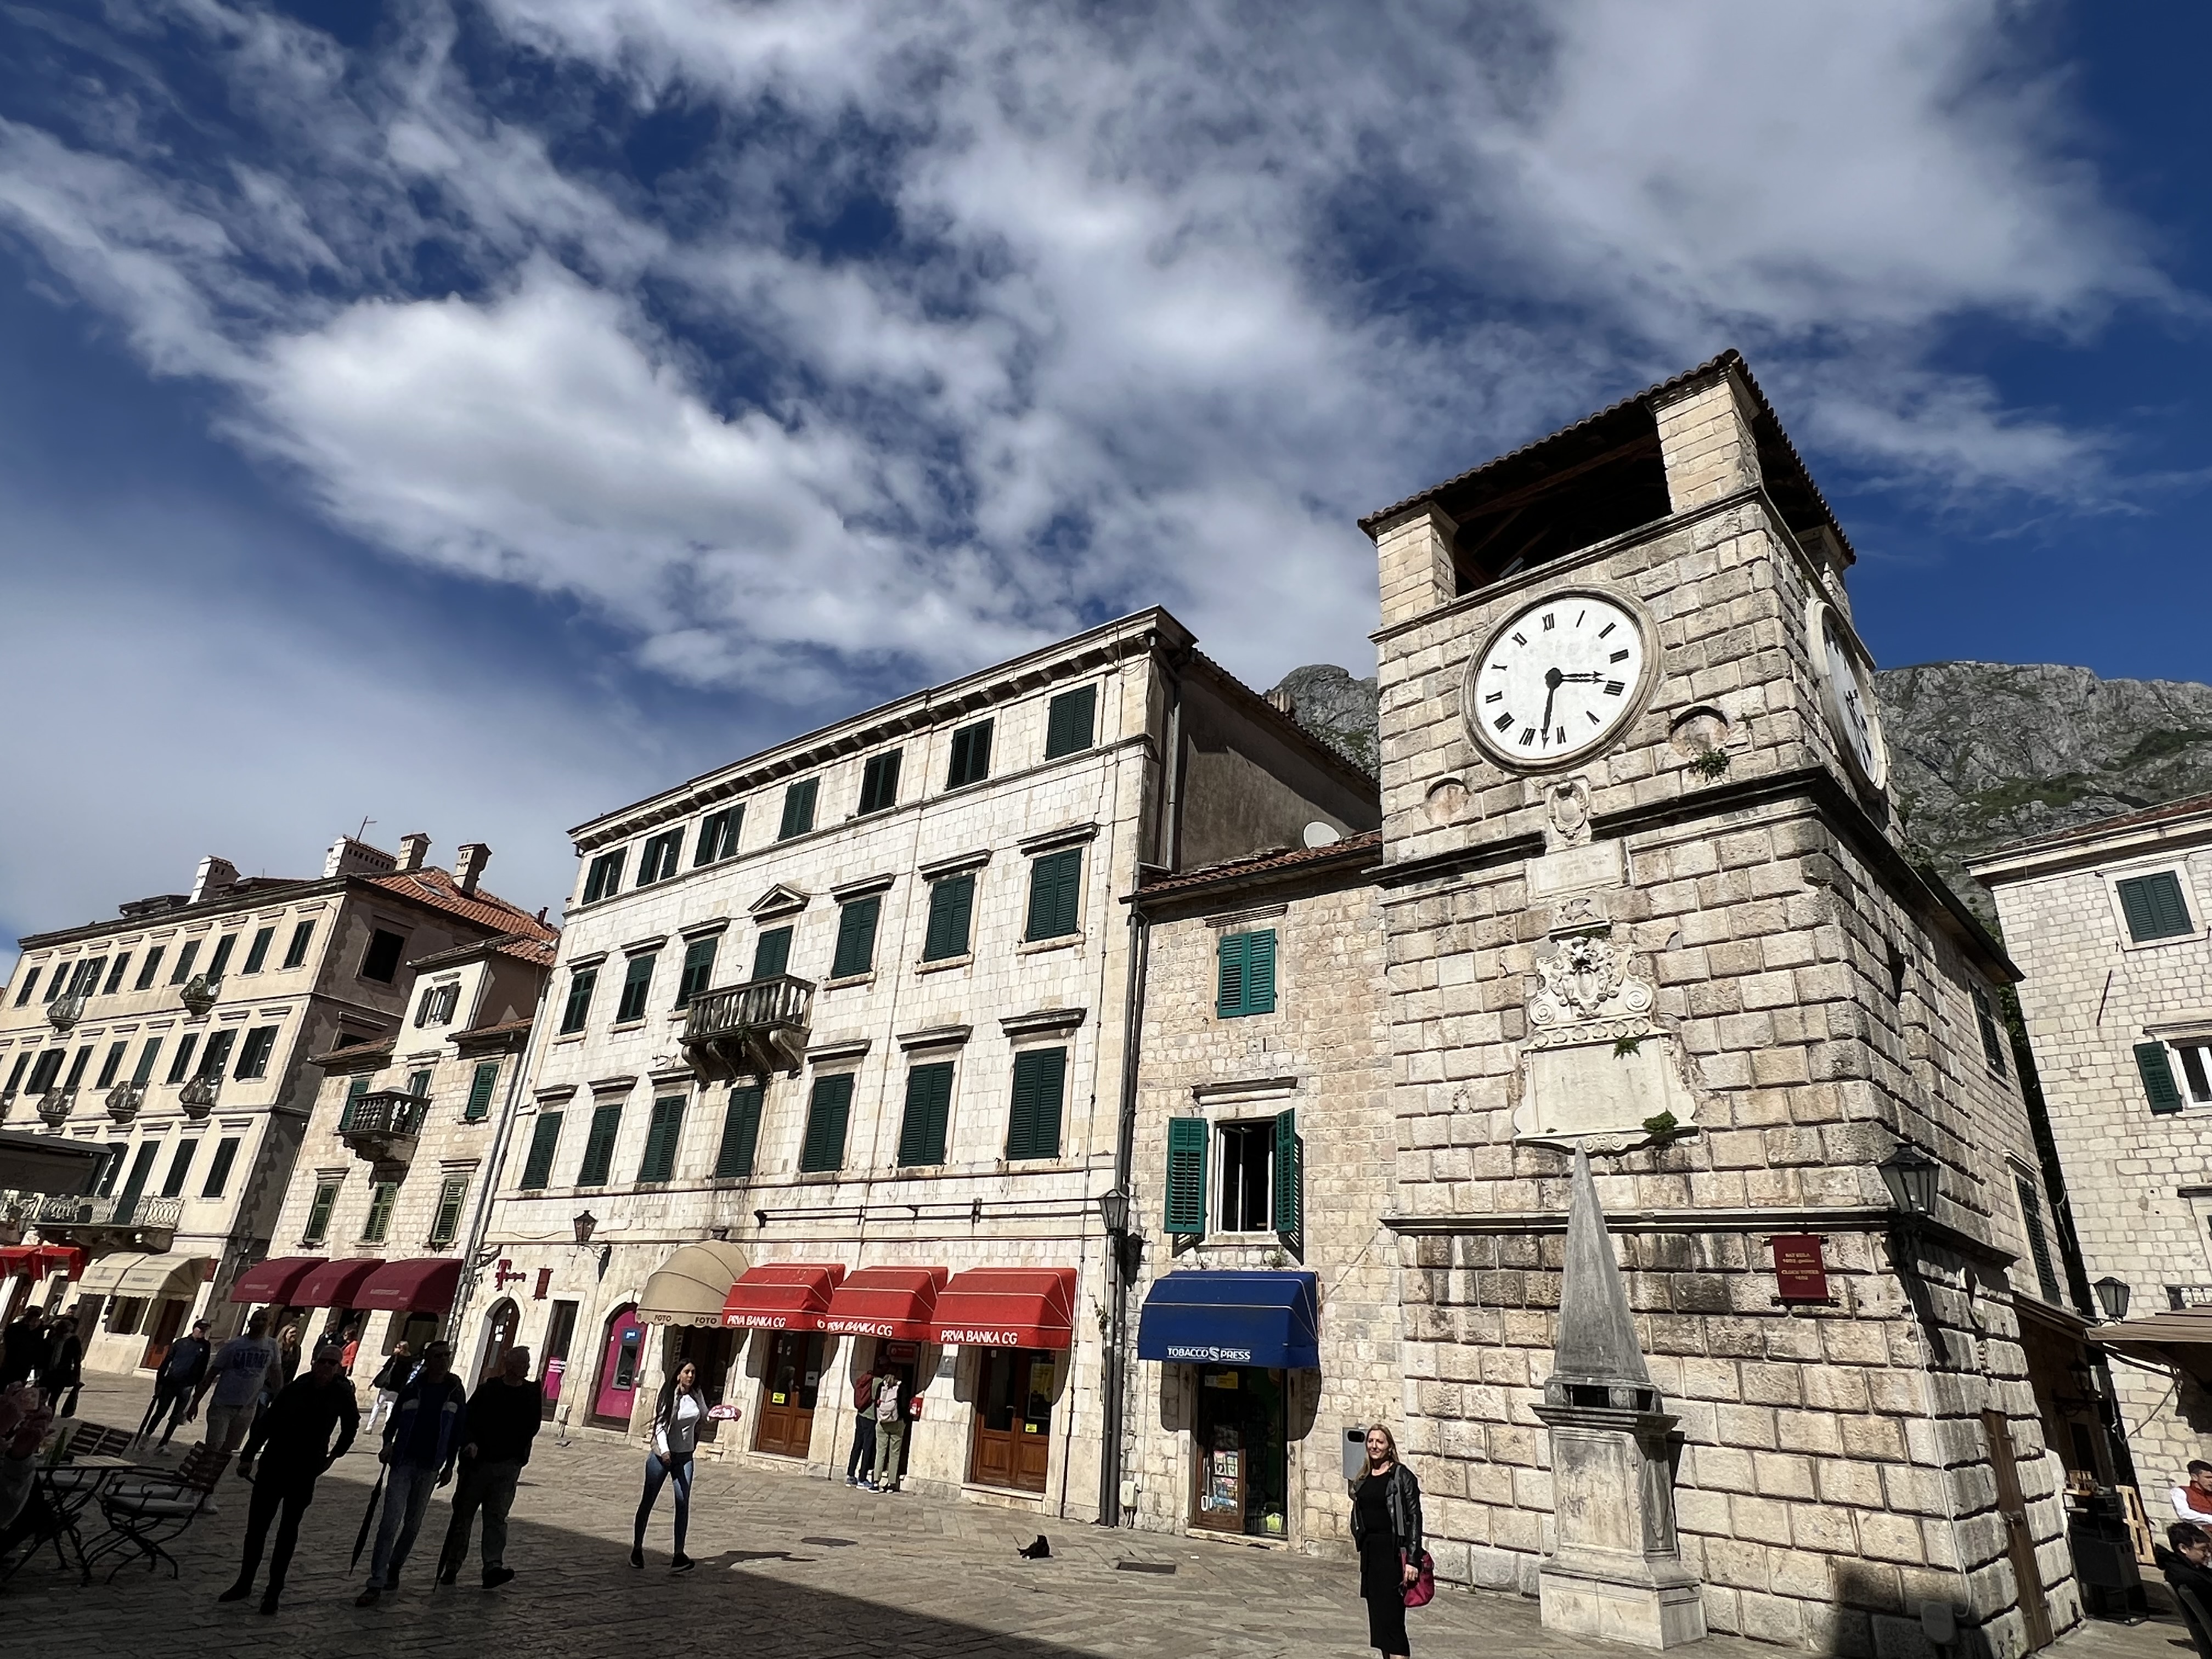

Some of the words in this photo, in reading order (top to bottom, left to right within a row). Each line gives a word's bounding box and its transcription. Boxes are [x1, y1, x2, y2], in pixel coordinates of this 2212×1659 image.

[1542, 612, 1555, 633] XII
[727, 1314, 745, 1325] PRVA
[746, 1316, 772, 1327] BANKA
[773, 1317, 787, 1328] CG
[827, 1321, 845, 1331] PRVA
[844, 1321, 876, 1334] BANKA
[877, 1324, 894, 1337] CG
[940, 1330, 964, 1342] PRVA
[966, 1330, 1000, 1344] BANKA
[1001, 1331, 1018, 1345] CG
[1167, 1347, 1209, 1358] TOBACCO
[1220, 1350, 1251, 1360] PRESS
